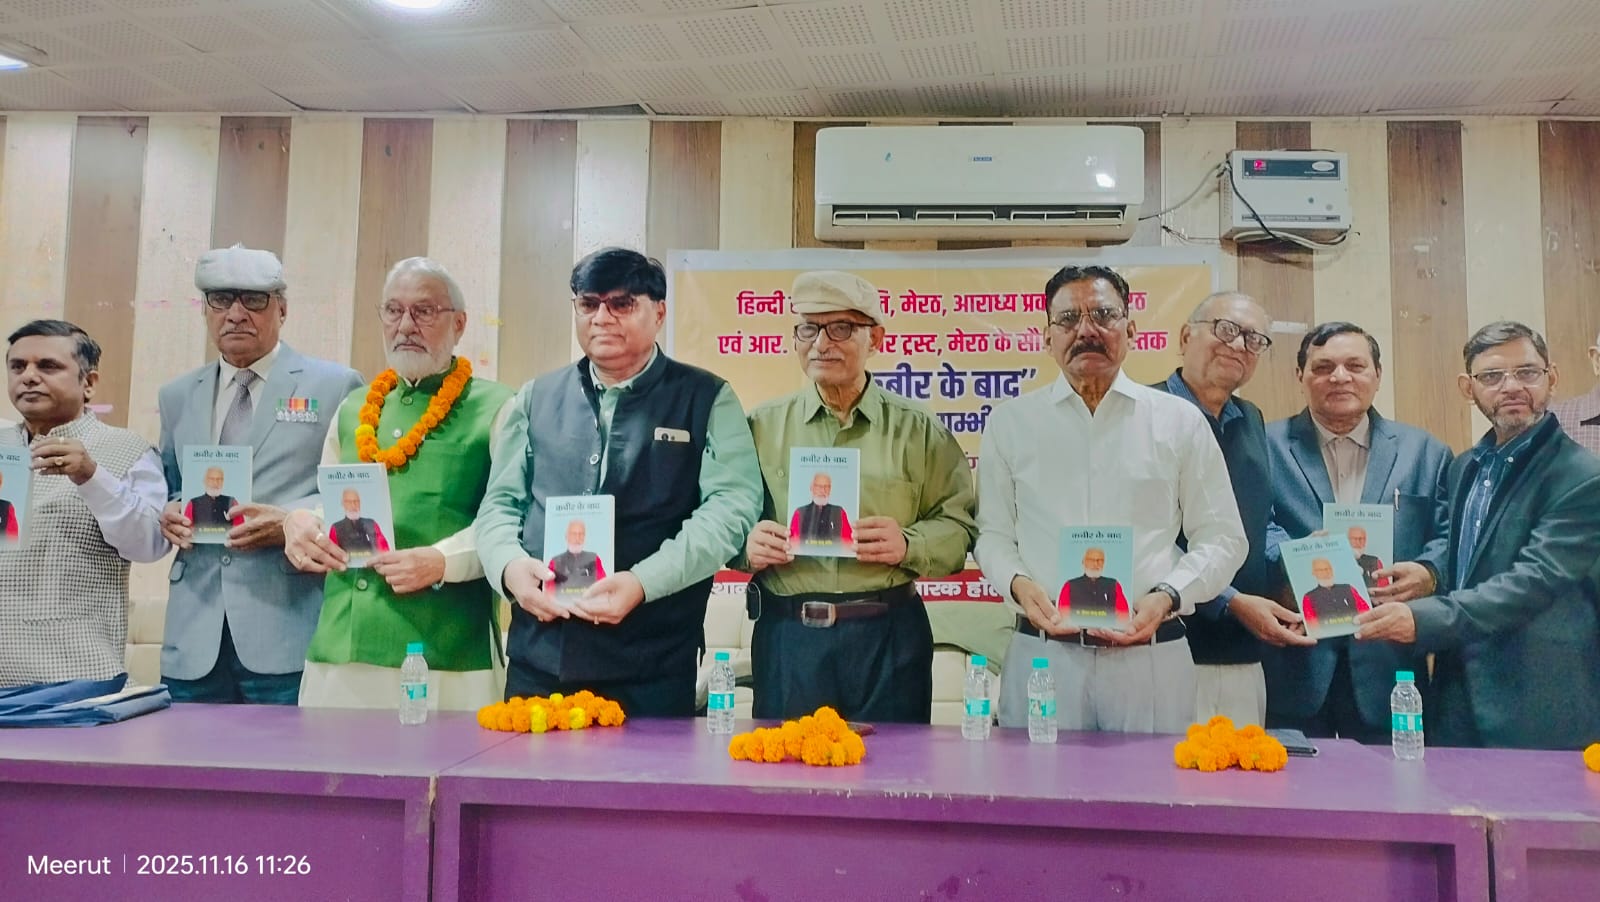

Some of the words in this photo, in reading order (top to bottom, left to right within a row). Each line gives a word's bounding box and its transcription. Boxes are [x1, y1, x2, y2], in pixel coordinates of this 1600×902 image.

[737, 290, 785, 315] हिन्दी
[900, 289, 948, 317] मेरठ,
[954, 292, 1018, 313] आराध्य
[717, 330, 743, 355] एवं
[749, 335, 788, 354] आर.
[901, 335, 943, 357] ट्रस्ट,
[947, 329, 990, 353] मेरठ
[994, 328, 1012, 352] के
[938, 362, 967, 399] के
